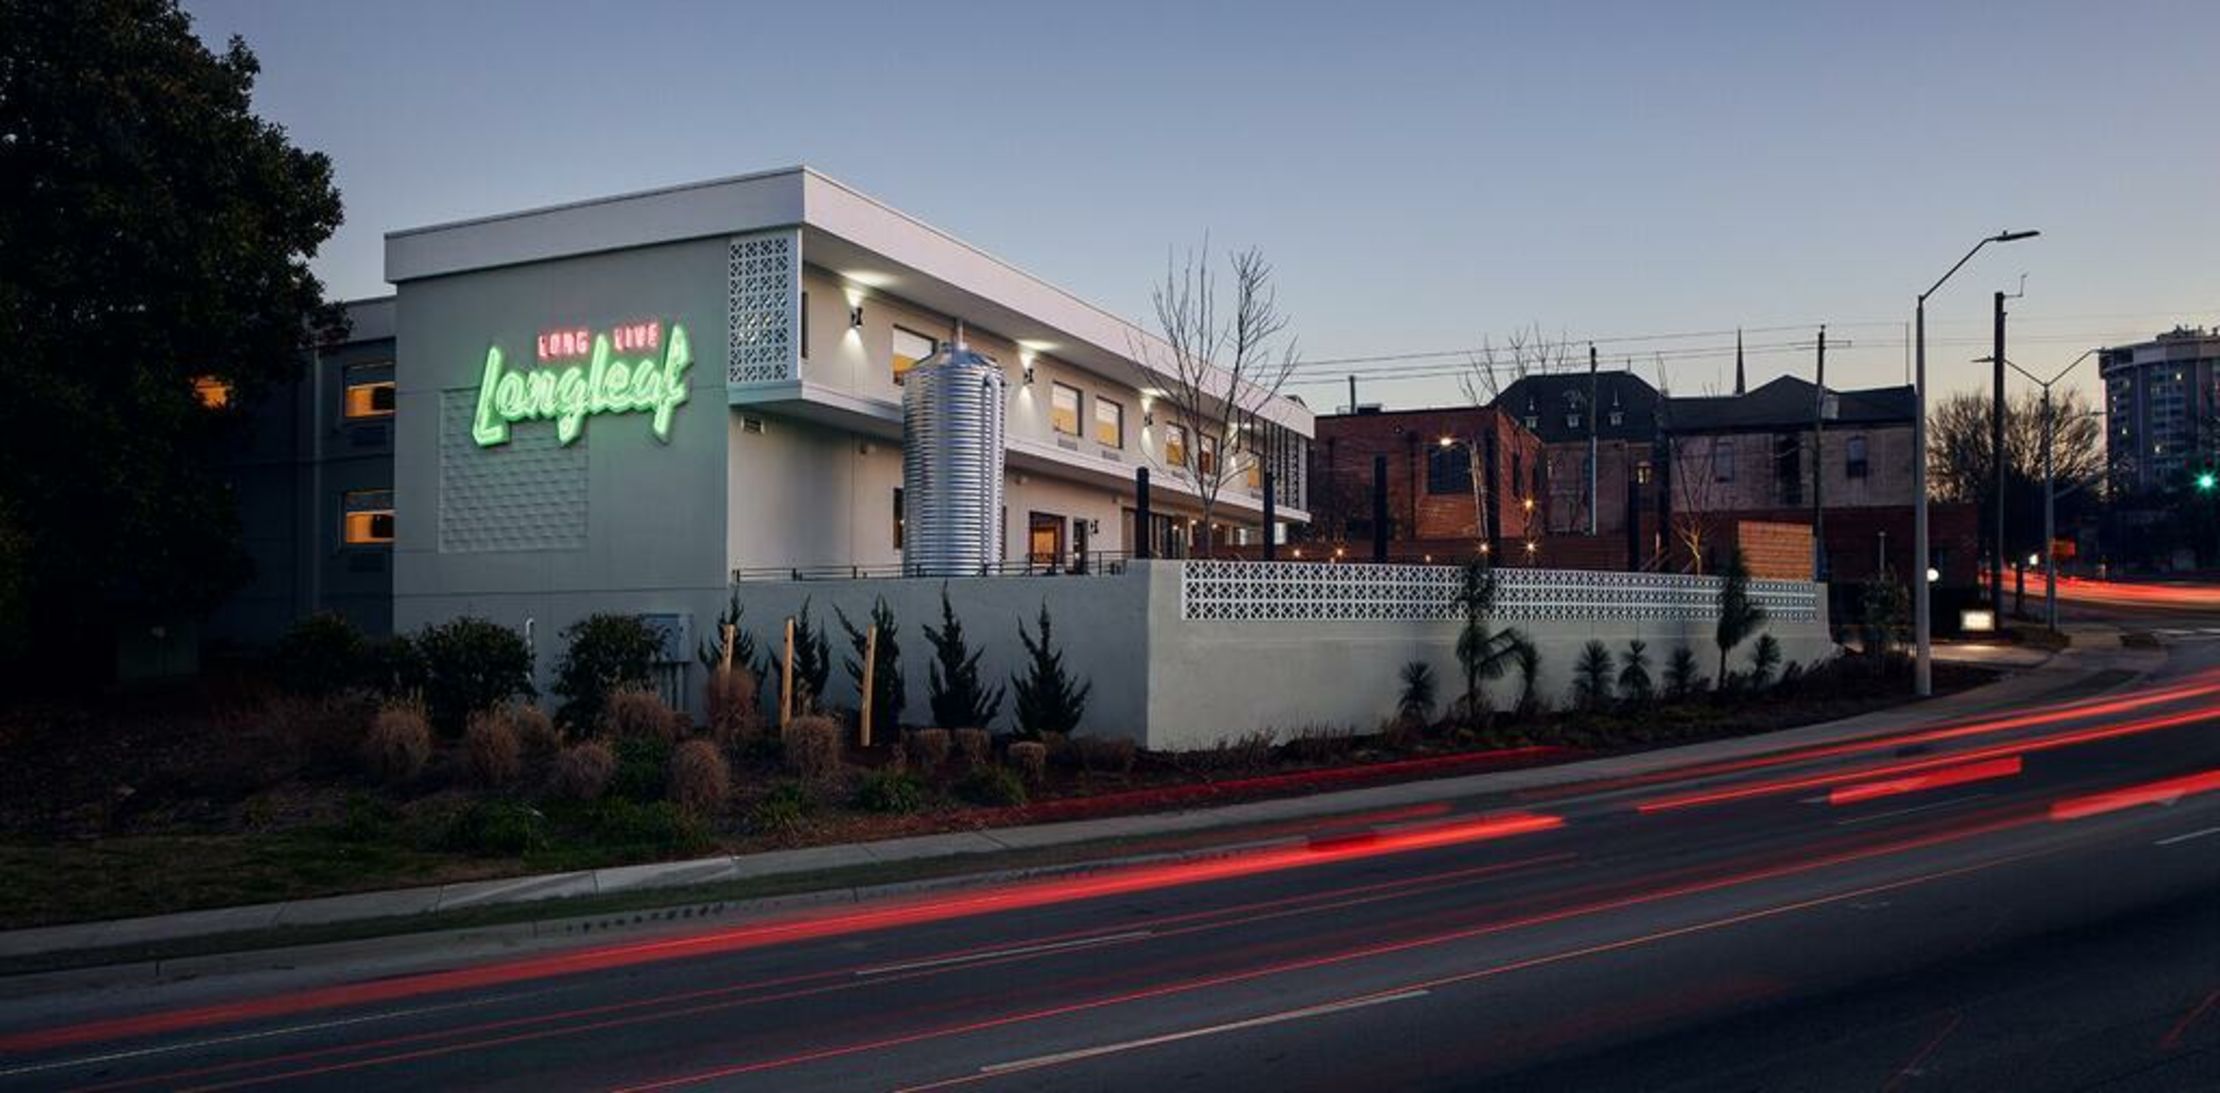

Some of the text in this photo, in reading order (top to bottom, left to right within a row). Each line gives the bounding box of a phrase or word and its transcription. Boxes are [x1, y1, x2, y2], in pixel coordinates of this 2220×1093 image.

[538, 323, 659, 357] LONG LIVE
[473, 324, 690, 445] Longleaf
